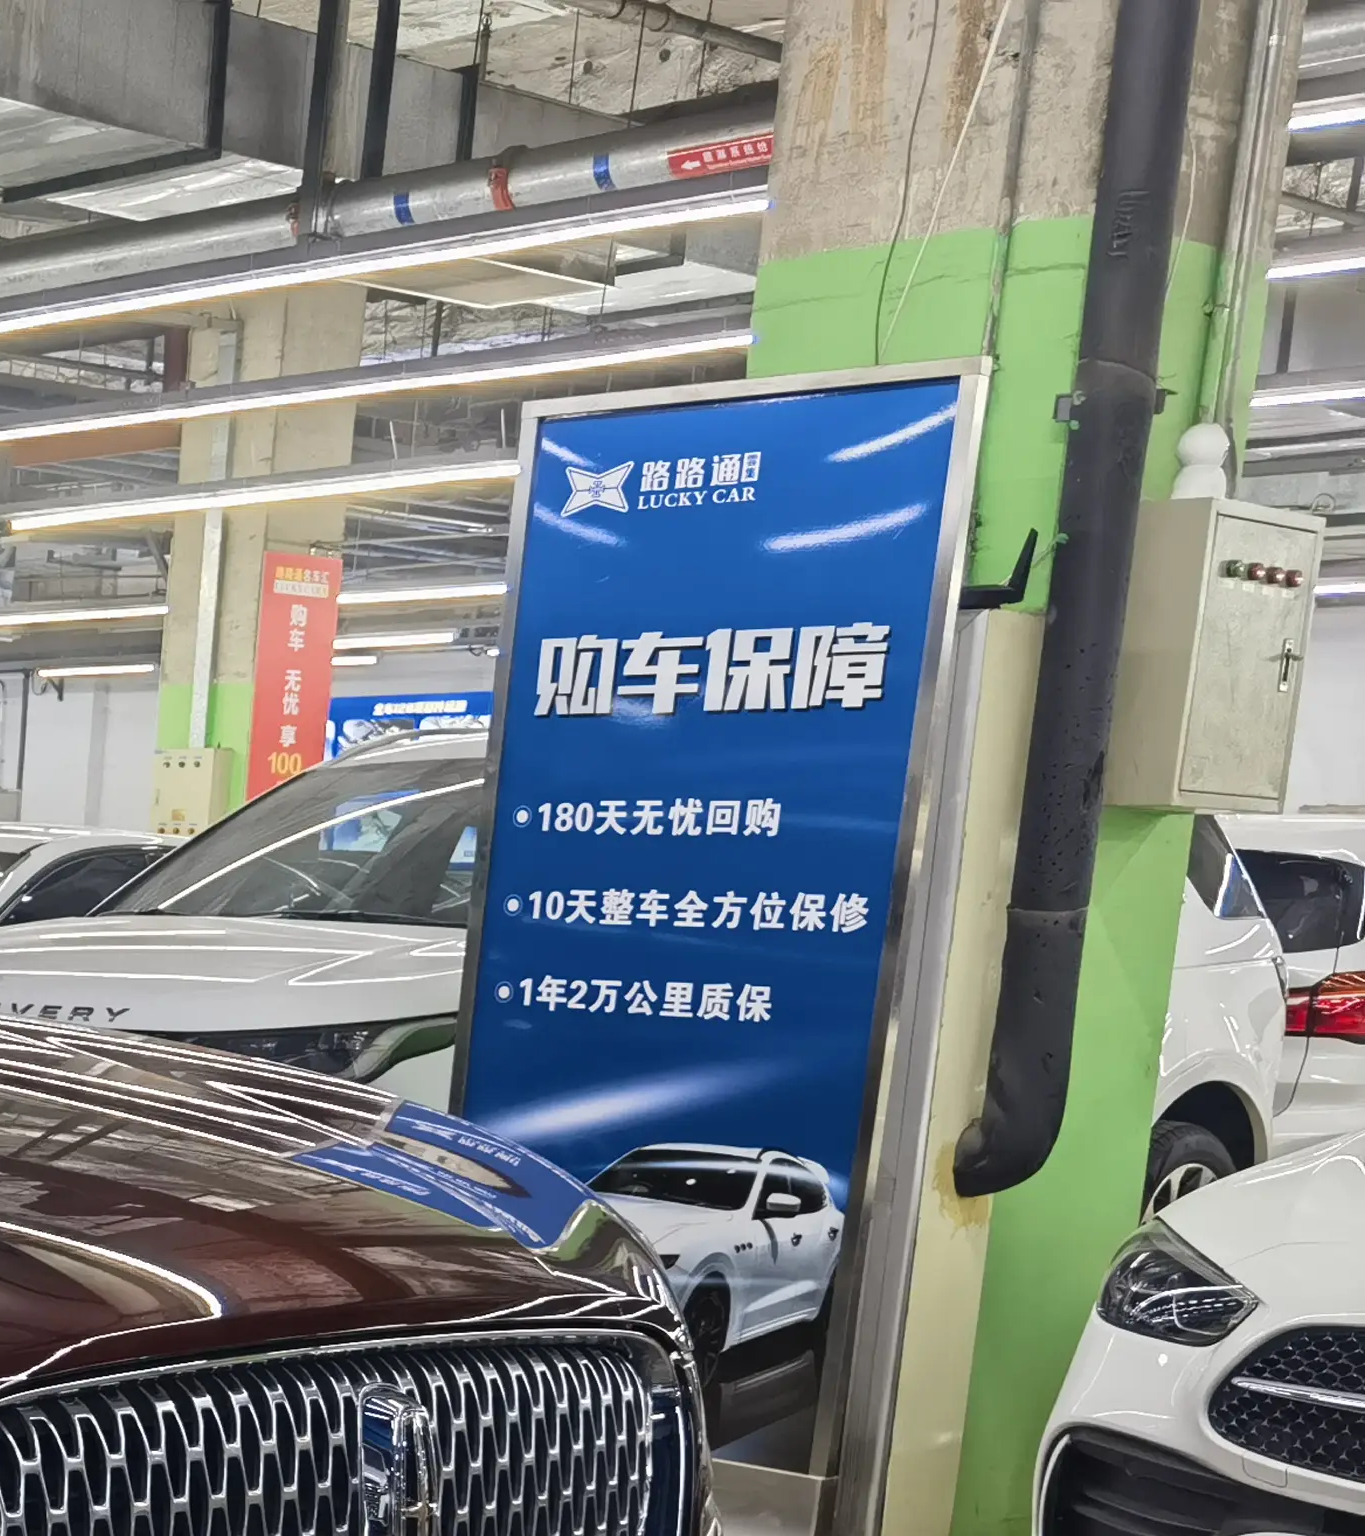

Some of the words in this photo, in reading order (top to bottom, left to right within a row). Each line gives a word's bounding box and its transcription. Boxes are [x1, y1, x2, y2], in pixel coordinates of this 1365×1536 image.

[640, 453, 742, 492] 路路通
[637, 490, 708, 510] LUCKY
[712, 486, 756, 504] CAR
[287, 604, 308, 652] 购车
[534, 621, 891, 717] 购车保障
[282, 669, 302, 716] 无忧
[267, 752, 303, 775] 100
[537, 797, 782, 837] 180天无忧回购
[527, 888, 870, 934] 10天整车全方位保修
[518, 974, 773, 1023] 1年2万公里质保
